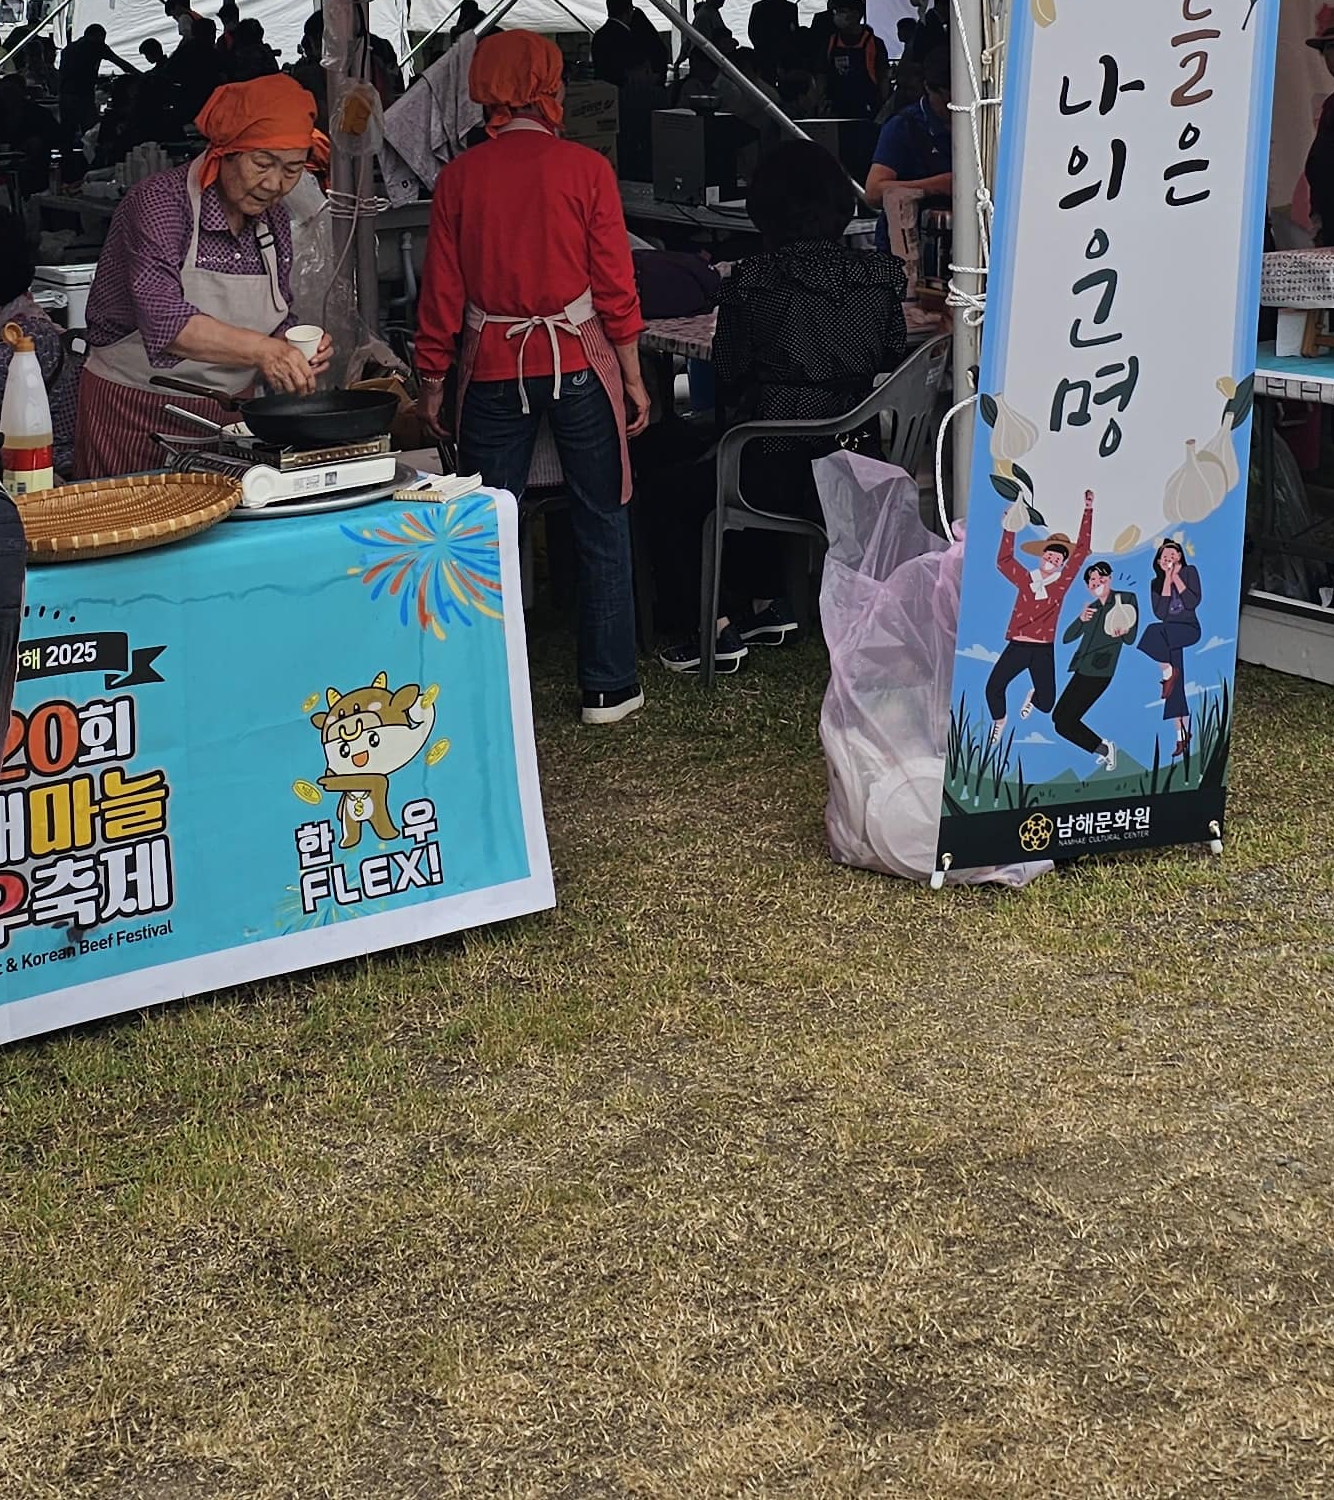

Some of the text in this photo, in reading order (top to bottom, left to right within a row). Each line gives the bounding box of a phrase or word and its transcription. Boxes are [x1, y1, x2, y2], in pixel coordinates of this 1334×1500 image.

[1049, 55, 1145, 458] 나의 운명
[17, 641, 98, 672] 해 2025
[1, 699, 132, 780] 20회
[296, 799, 438, 871] 한 우
[1056, 807, 1151, 838] 남해문화원
[1058, 829, 1151, 848] NAMHAE CULTURAL CENTER
[301, 843, 442, 912] FLEX!
[5, 920, 173, 973] & Korean Beef Festival
